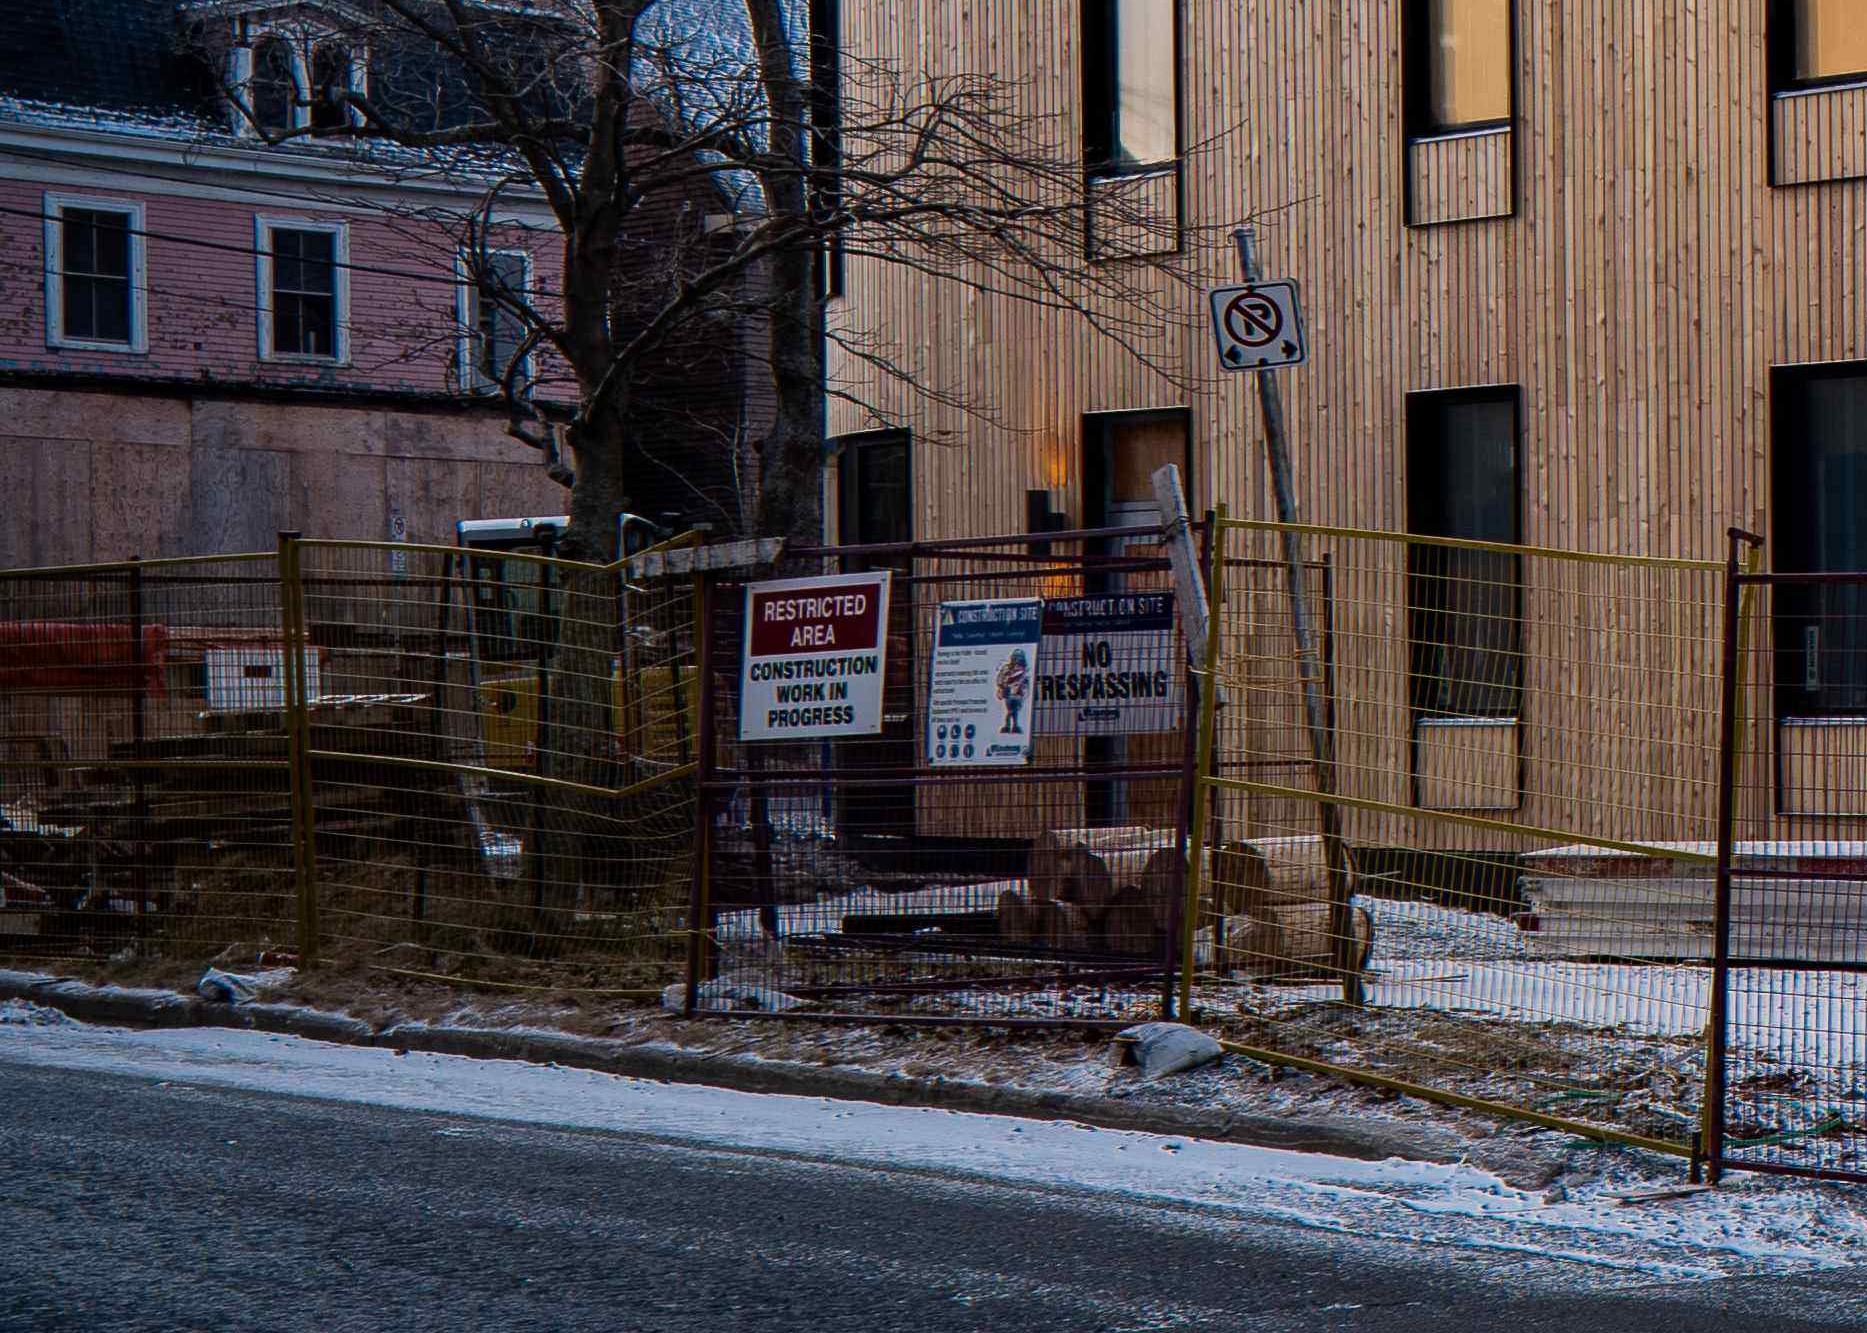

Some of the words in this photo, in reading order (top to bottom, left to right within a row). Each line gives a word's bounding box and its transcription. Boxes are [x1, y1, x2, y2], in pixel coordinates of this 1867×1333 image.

[764, 594, 866, 622] RESTRICTED
[1018, 606, 1039, 621] SITE
[1138, 597, 1165, 615] SITE
[790, 624, 836, 648] AREA
[1083, 640, 1112, 668] NO
[751, 655, 878, 682] CONSTRUCTION
[776, 682, 826, 703] WORK
[829, 681, 848, 701] IN
[768, 705, 854, 728] PROGRESS
